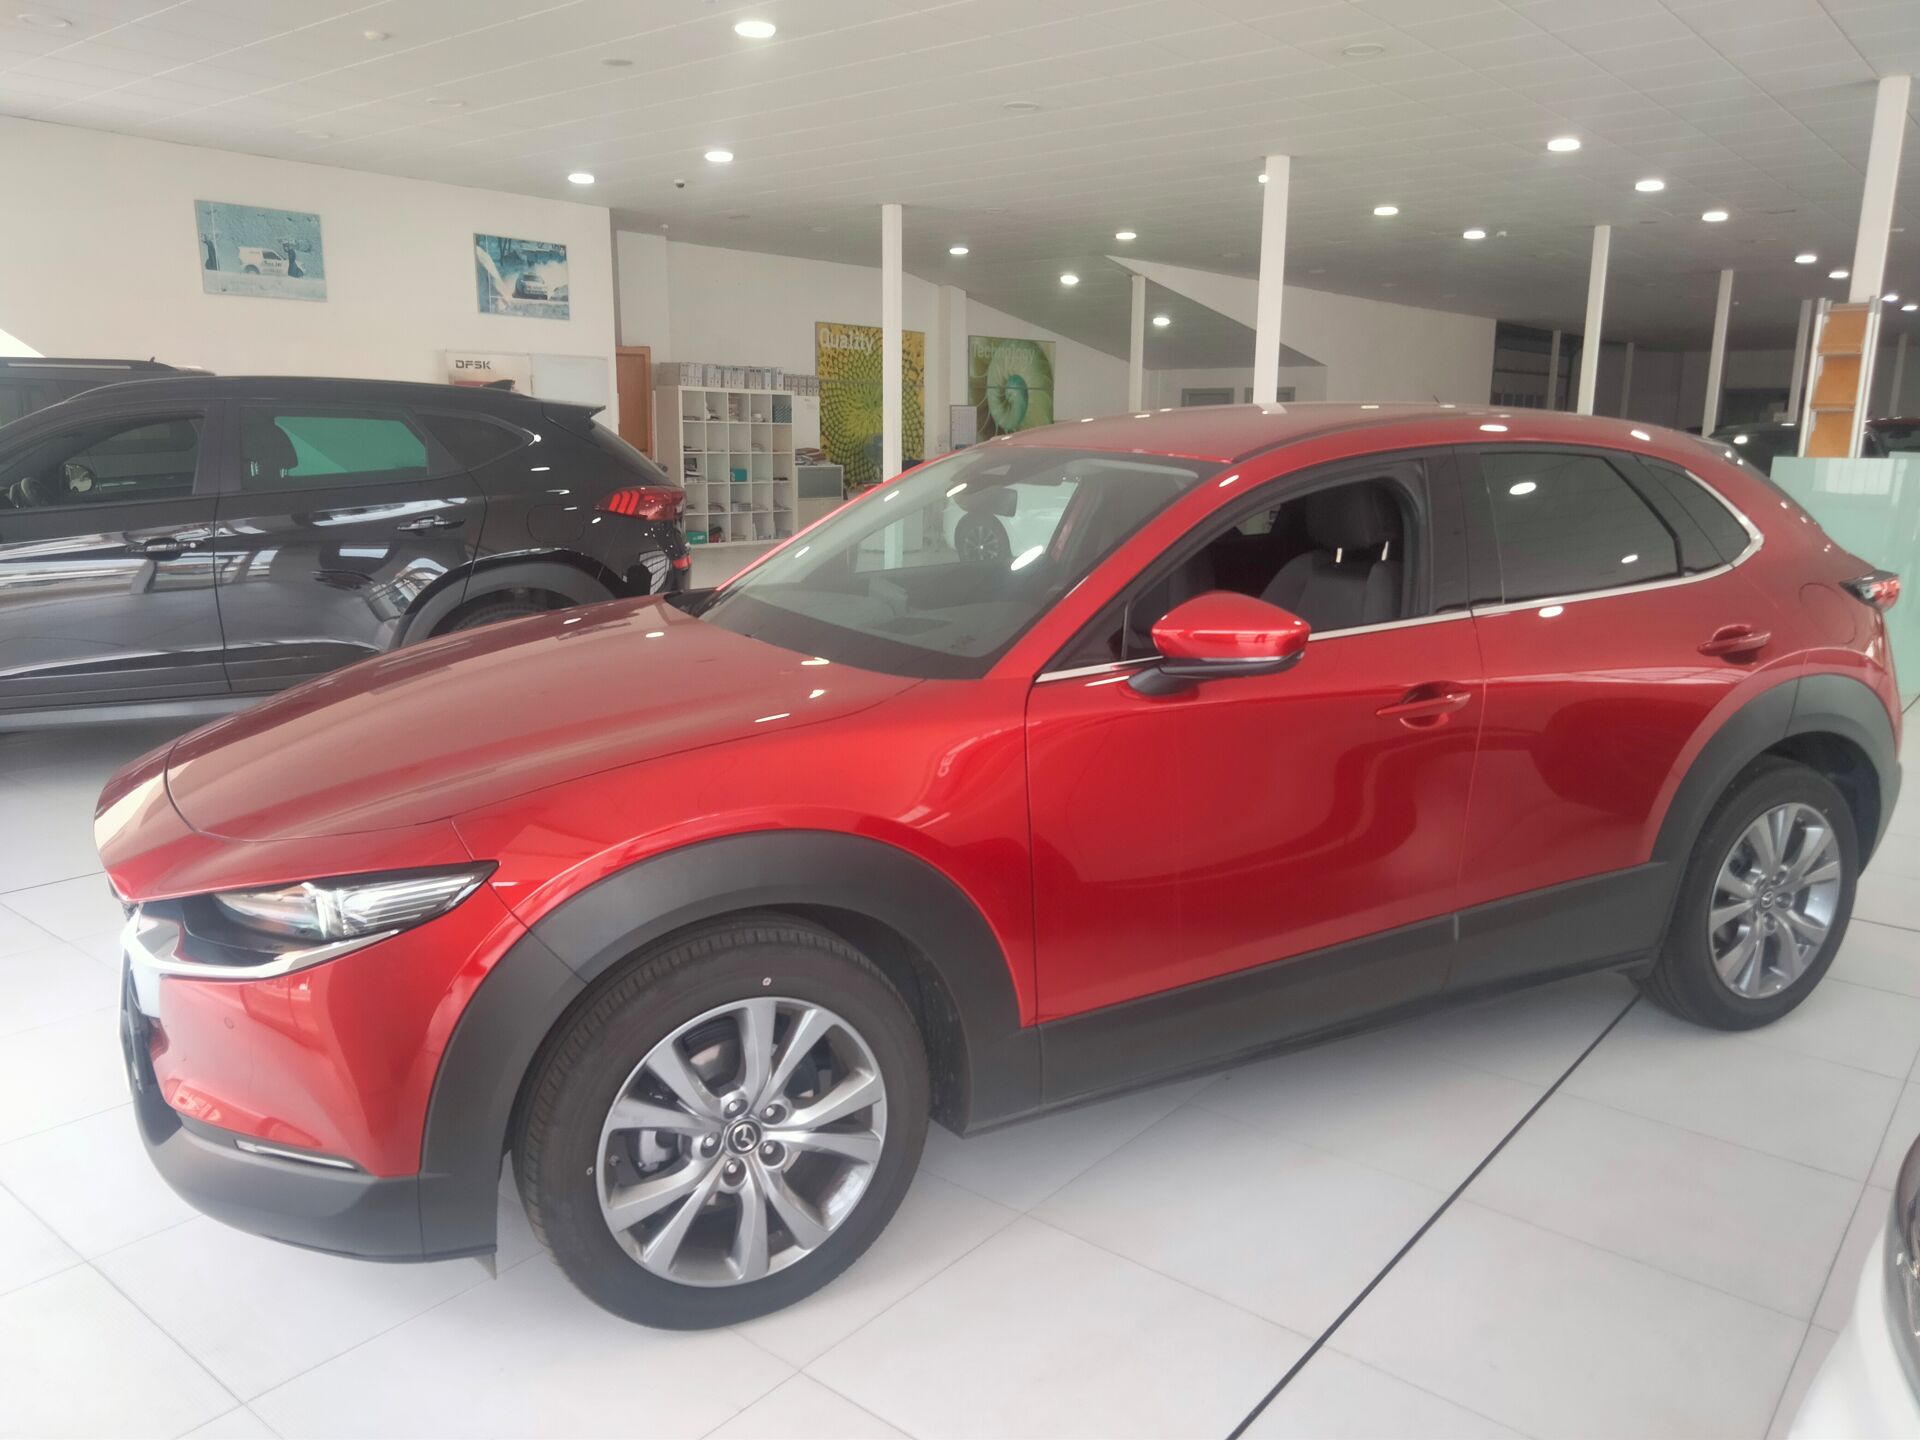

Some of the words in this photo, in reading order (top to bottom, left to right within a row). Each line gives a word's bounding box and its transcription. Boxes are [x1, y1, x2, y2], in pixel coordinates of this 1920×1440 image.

[820, 327, 875, 356] Quality
[971, 342, 1036, 364] Technology
[455, 359, 491, 370] DFSK
